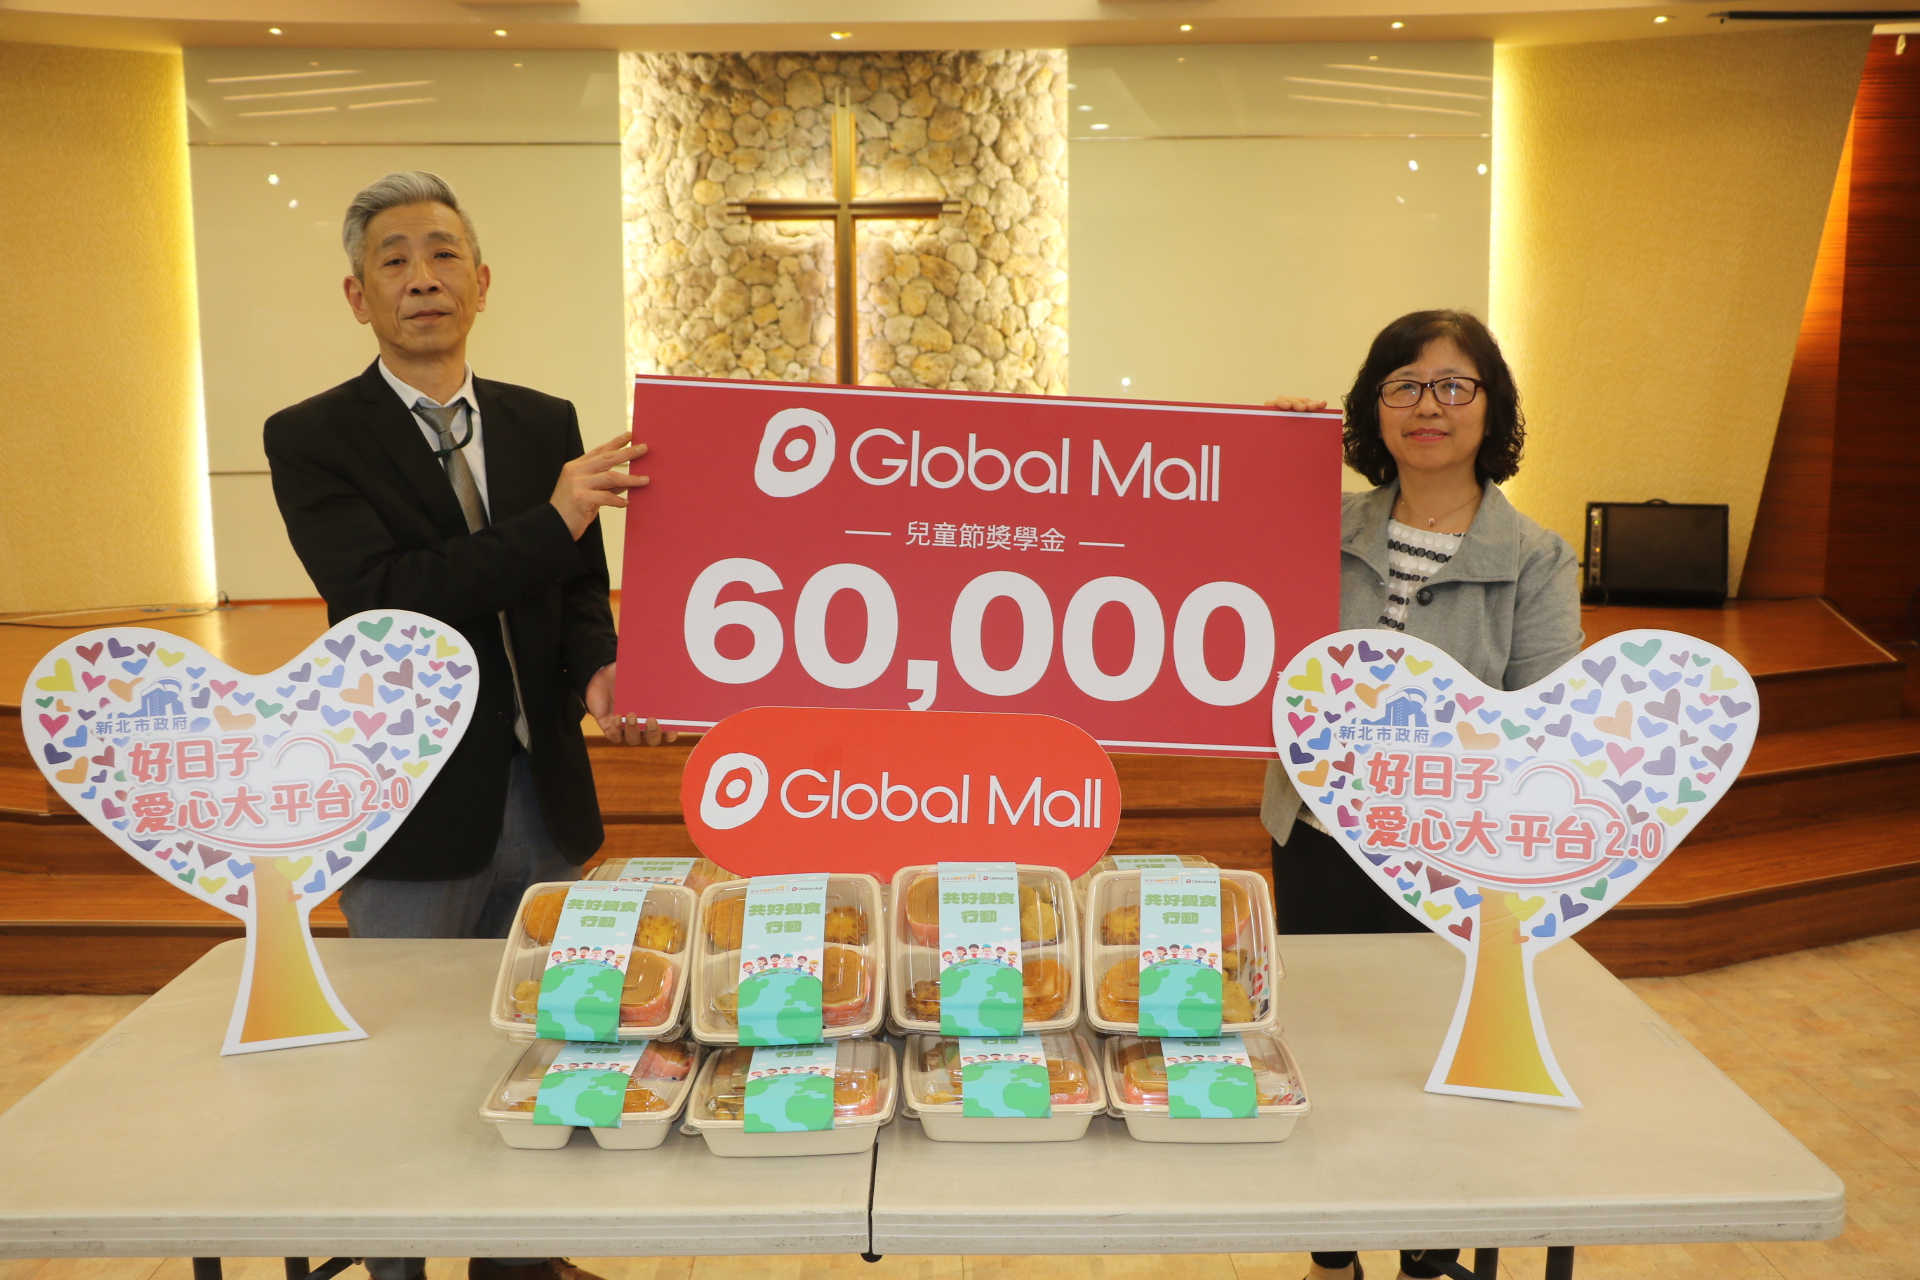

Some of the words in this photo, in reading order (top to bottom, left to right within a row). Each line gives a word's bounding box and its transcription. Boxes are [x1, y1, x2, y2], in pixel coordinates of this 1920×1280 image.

[849, 427, 1071, 495] Global
[1091, 439, 1221, 502] Mall
[905, 520, 1067, 553] 兒童節獎學金
[683, 557, 1276, 711] 60,000
[94, 716, 188, 735] 新北市政府
[1338, 724, 1431, 743] 新北市政府
[128, 737, 259, 783] 好日子
[1367, 753, 1499, 800] 好日子
[780, 768, 970, 824] Global
[987, 775, 1102, 829] Mall
[567, 899, 639, 912] 共好餐食
[942, 892, 1015, 905] 共好餐食
[1144, 893, 1217, 907] 共好餐食
[748, 902, 821, 916] 共好餐食
[961, 910, 997, 923] 行動
[580, 915, 617, 928] 行動
[1162, 912, 1199, 924] 行動
[765, 920, 802, 934] 行動
